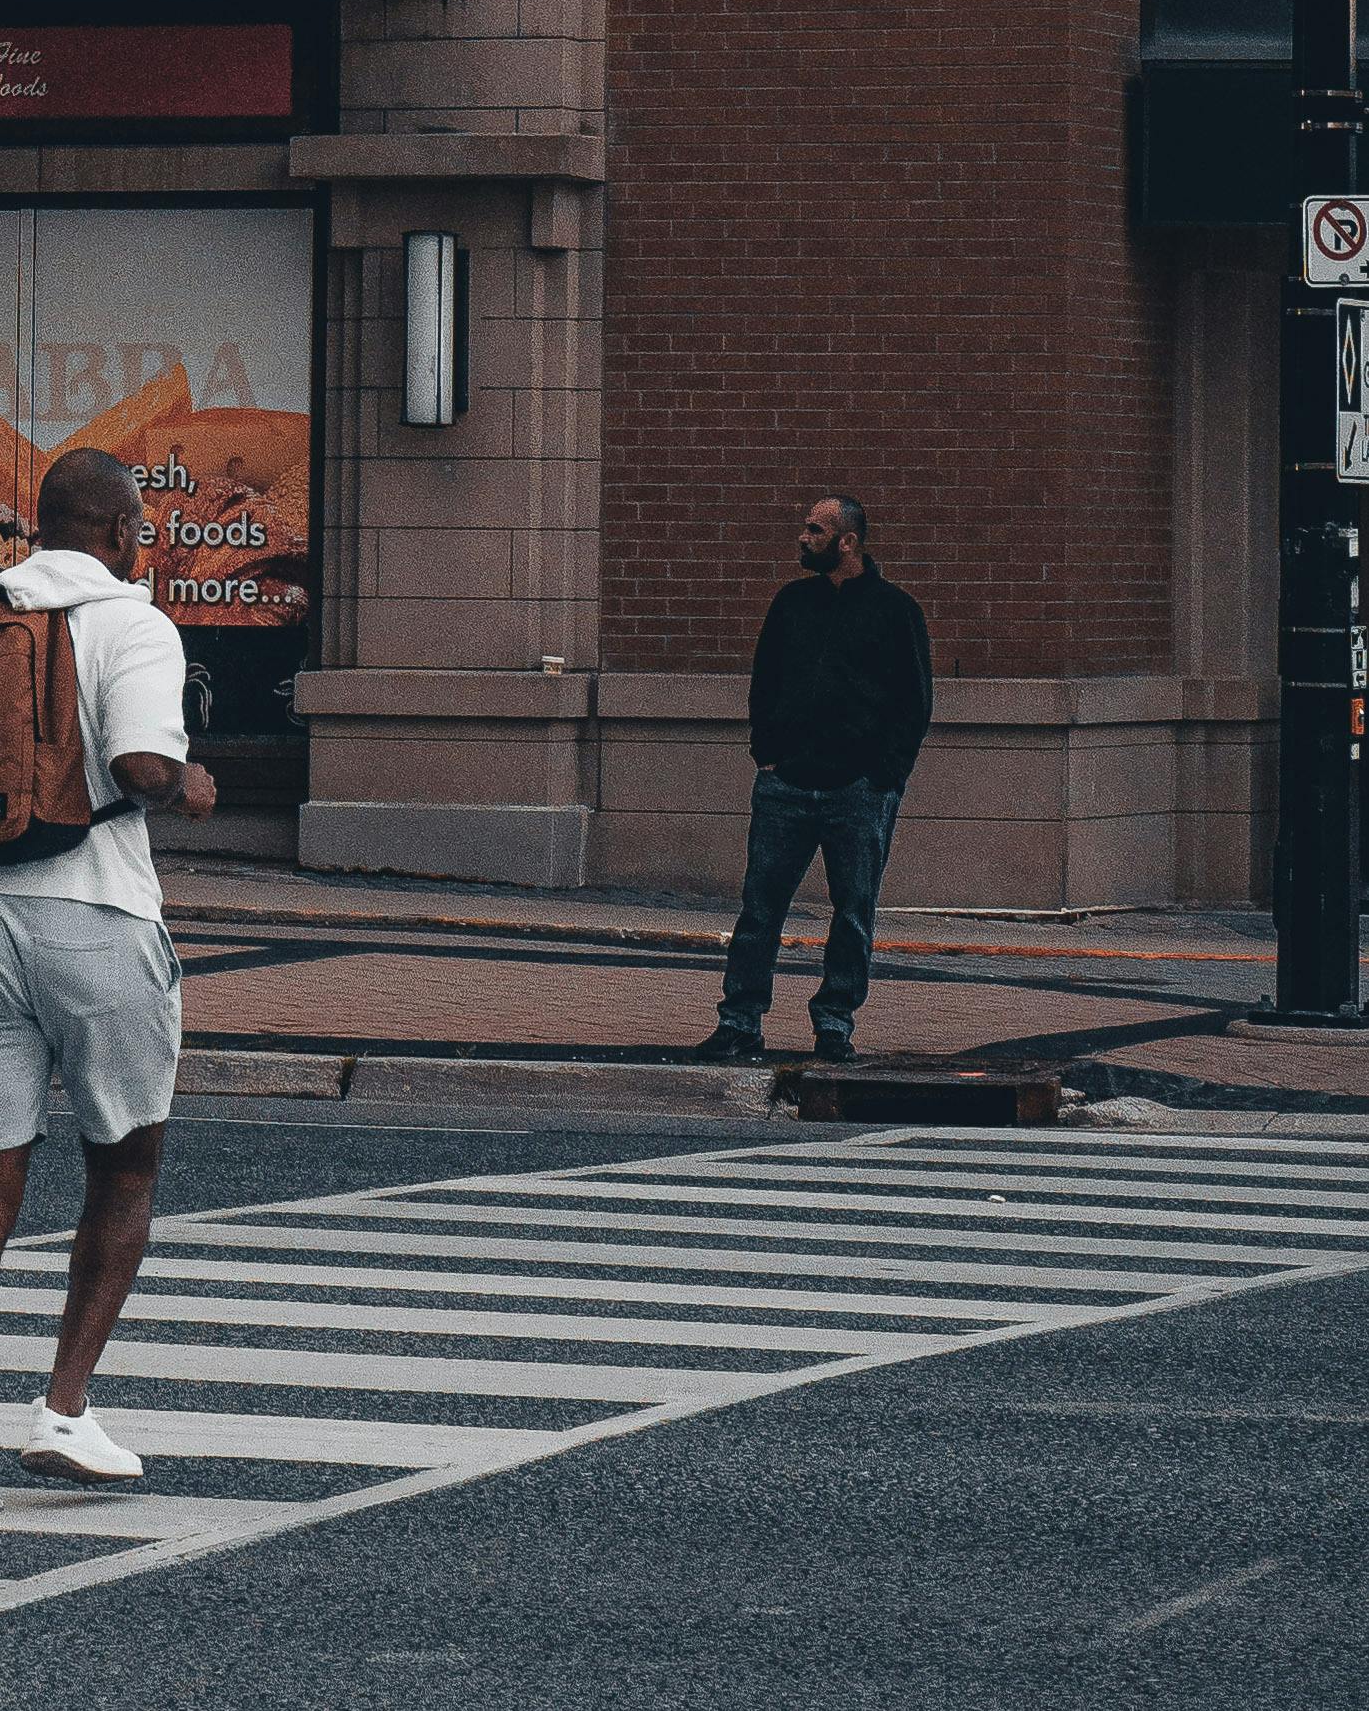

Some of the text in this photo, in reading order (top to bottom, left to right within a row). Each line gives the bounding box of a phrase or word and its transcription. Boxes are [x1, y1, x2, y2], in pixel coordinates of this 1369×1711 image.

[130, 454, 196, 493] esh,
[166, 511, 266, 546] foods
[168, 579, 293, 603] more...
